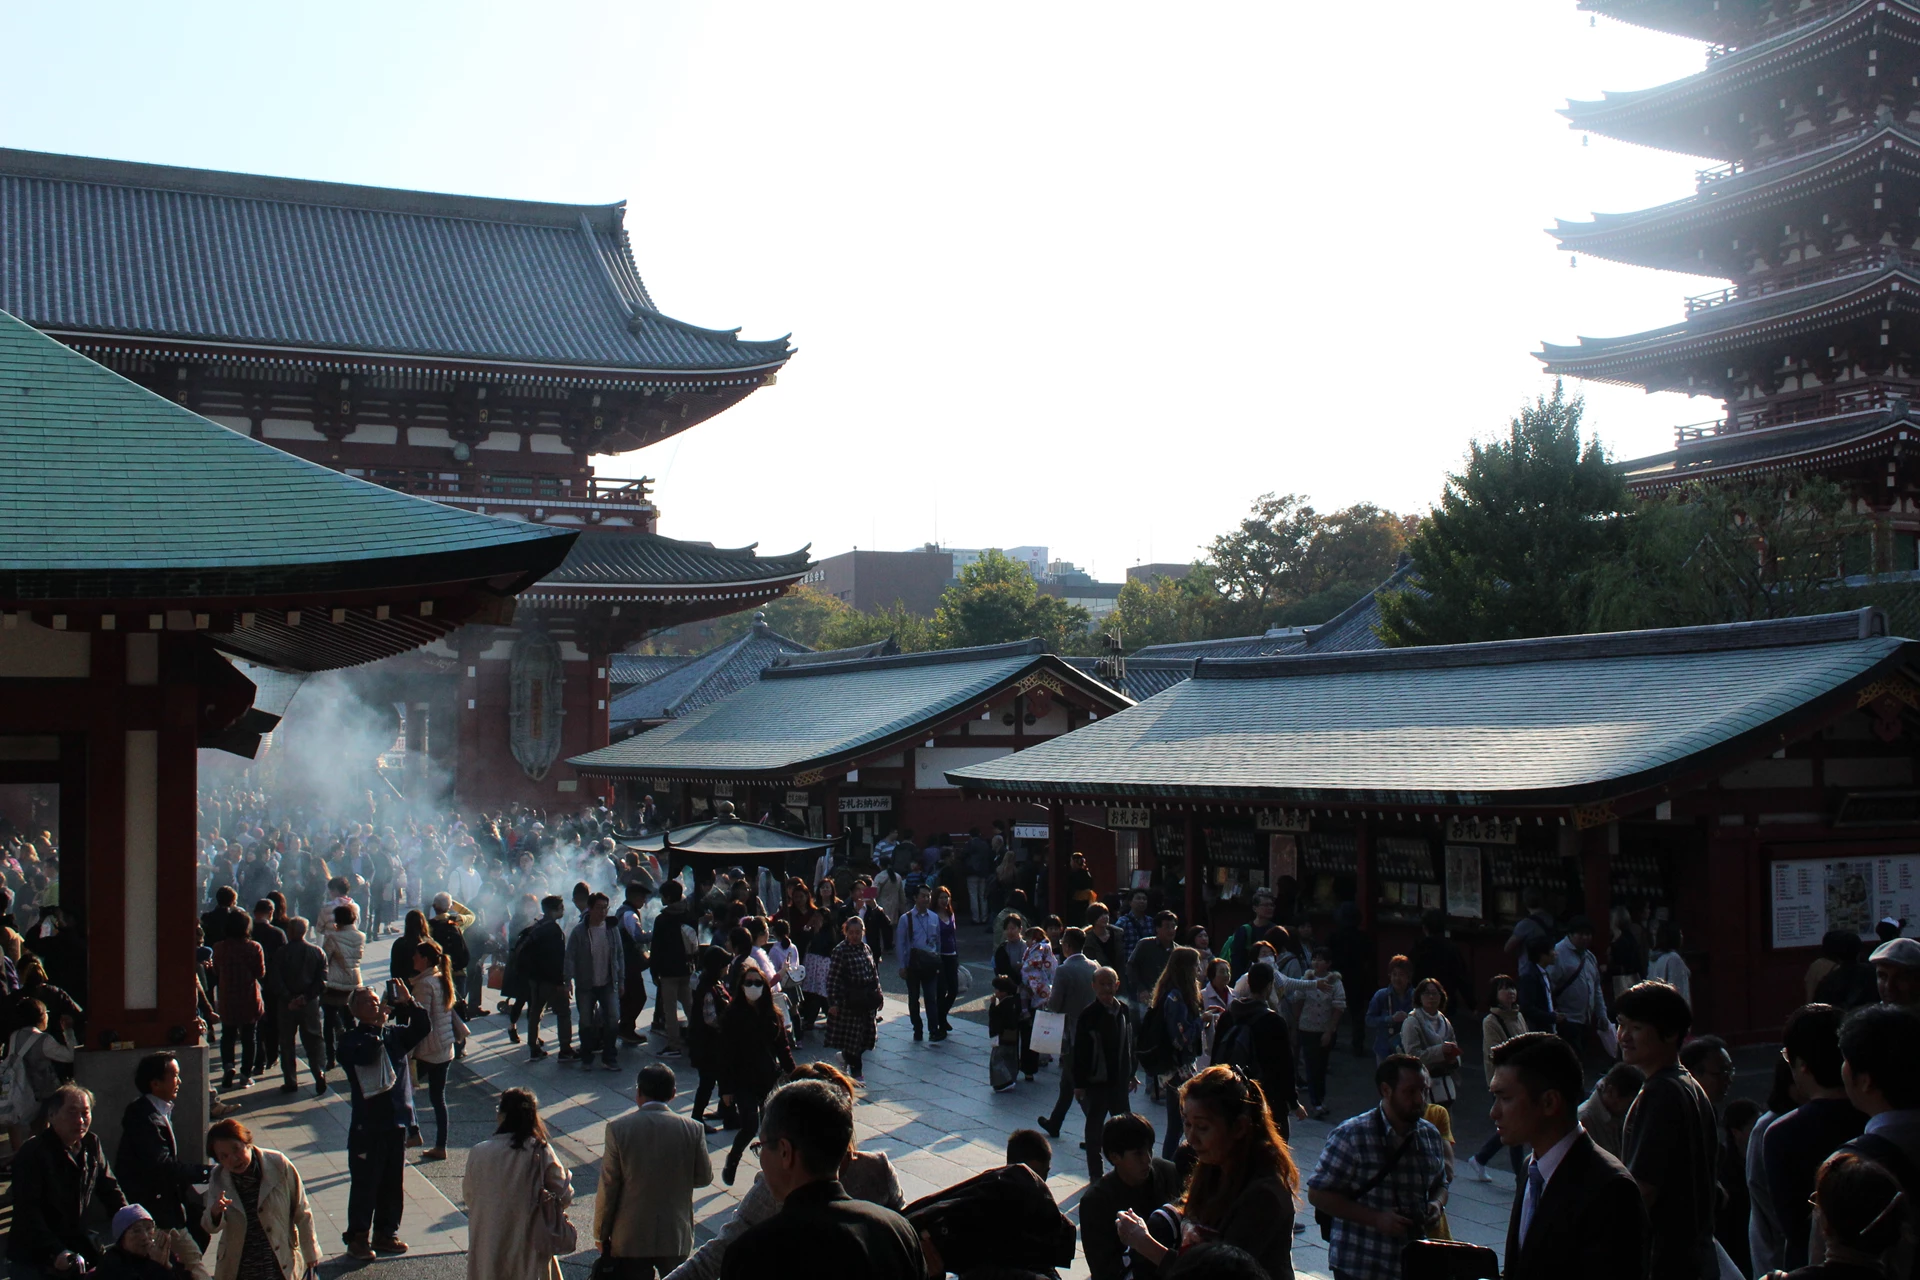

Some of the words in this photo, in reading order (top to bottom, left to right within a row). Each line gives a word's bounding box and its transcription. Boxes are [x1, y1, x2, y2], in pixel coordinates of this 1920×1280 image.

[839, 798, 889, 809] 古札お納め所
[1111, 809, 1148, 826] お札お守
[1260, 812, 1306, 829] お札お守
[1452, 820, 1513, 842] お札お守
